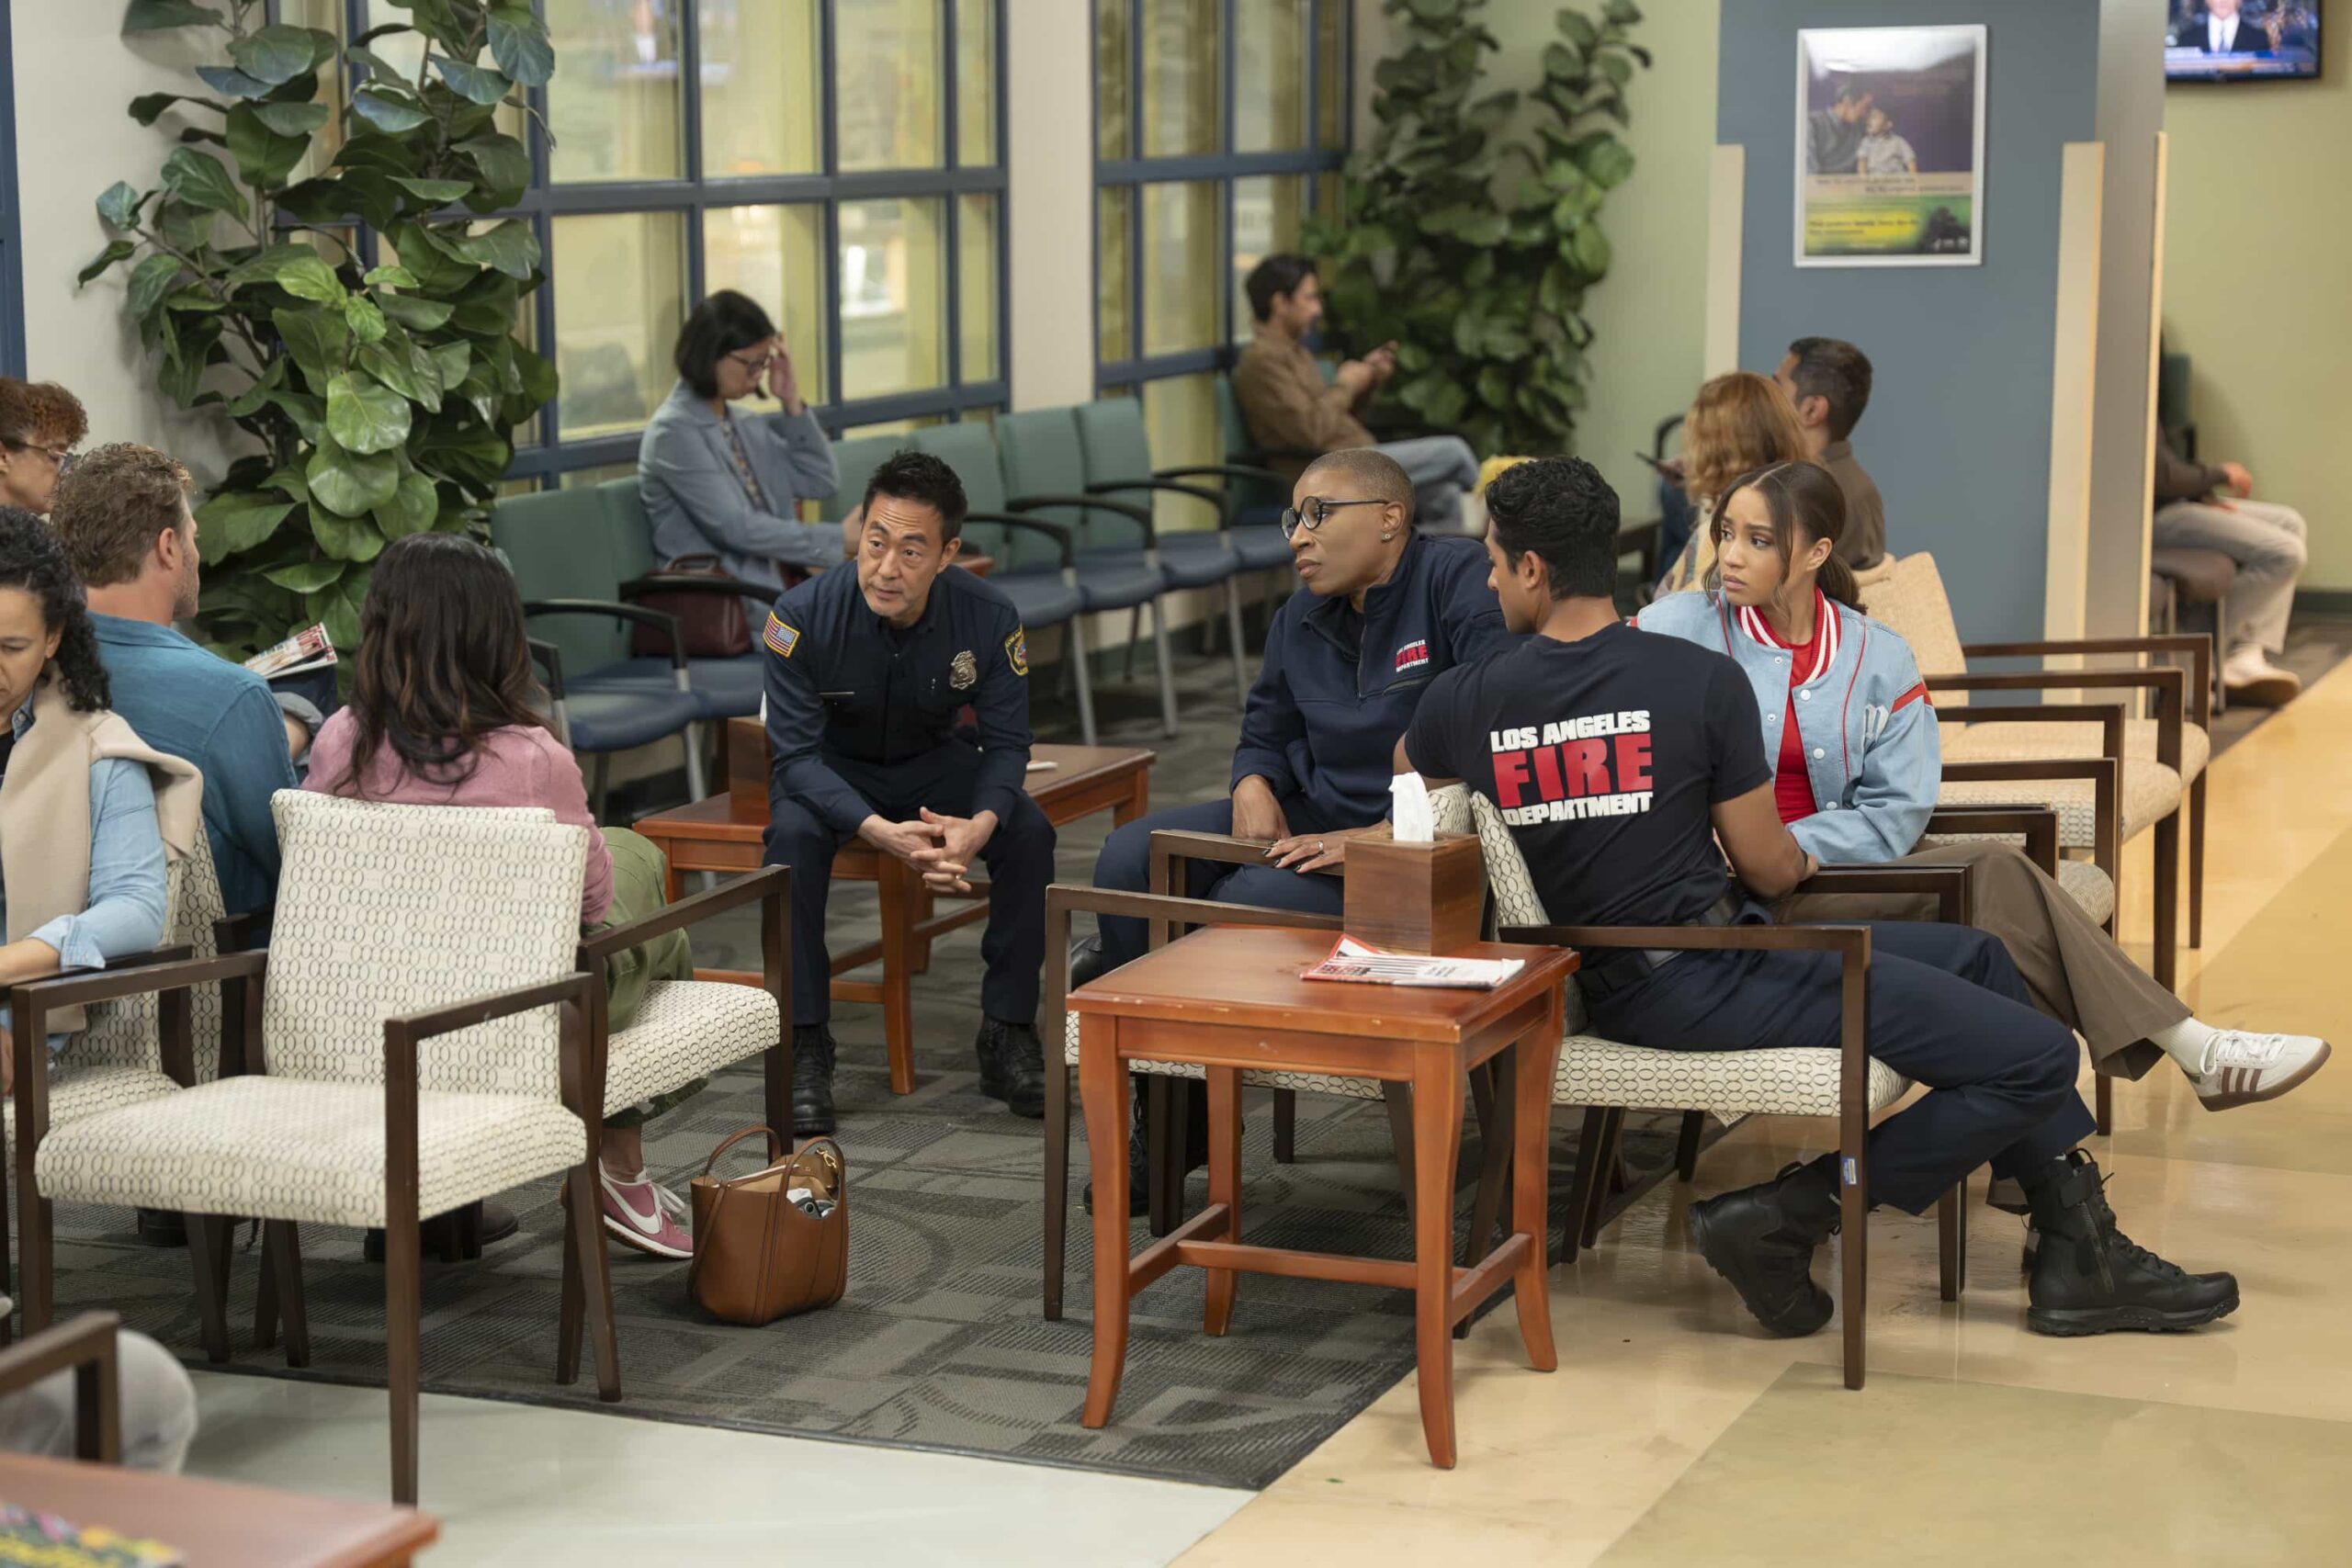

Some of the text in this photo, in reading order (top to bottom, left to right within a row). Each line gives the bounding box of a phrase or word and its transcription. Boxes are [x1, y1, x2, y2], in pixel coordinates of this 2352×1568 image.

[1396, 645, 1428, 669] FIRE
[1490, 710, 1650, 752] LOS ANGELES
[1492, 733, 1653, 808] FIRE
[1501, 791, 1654, 827] DEPARTMENT
